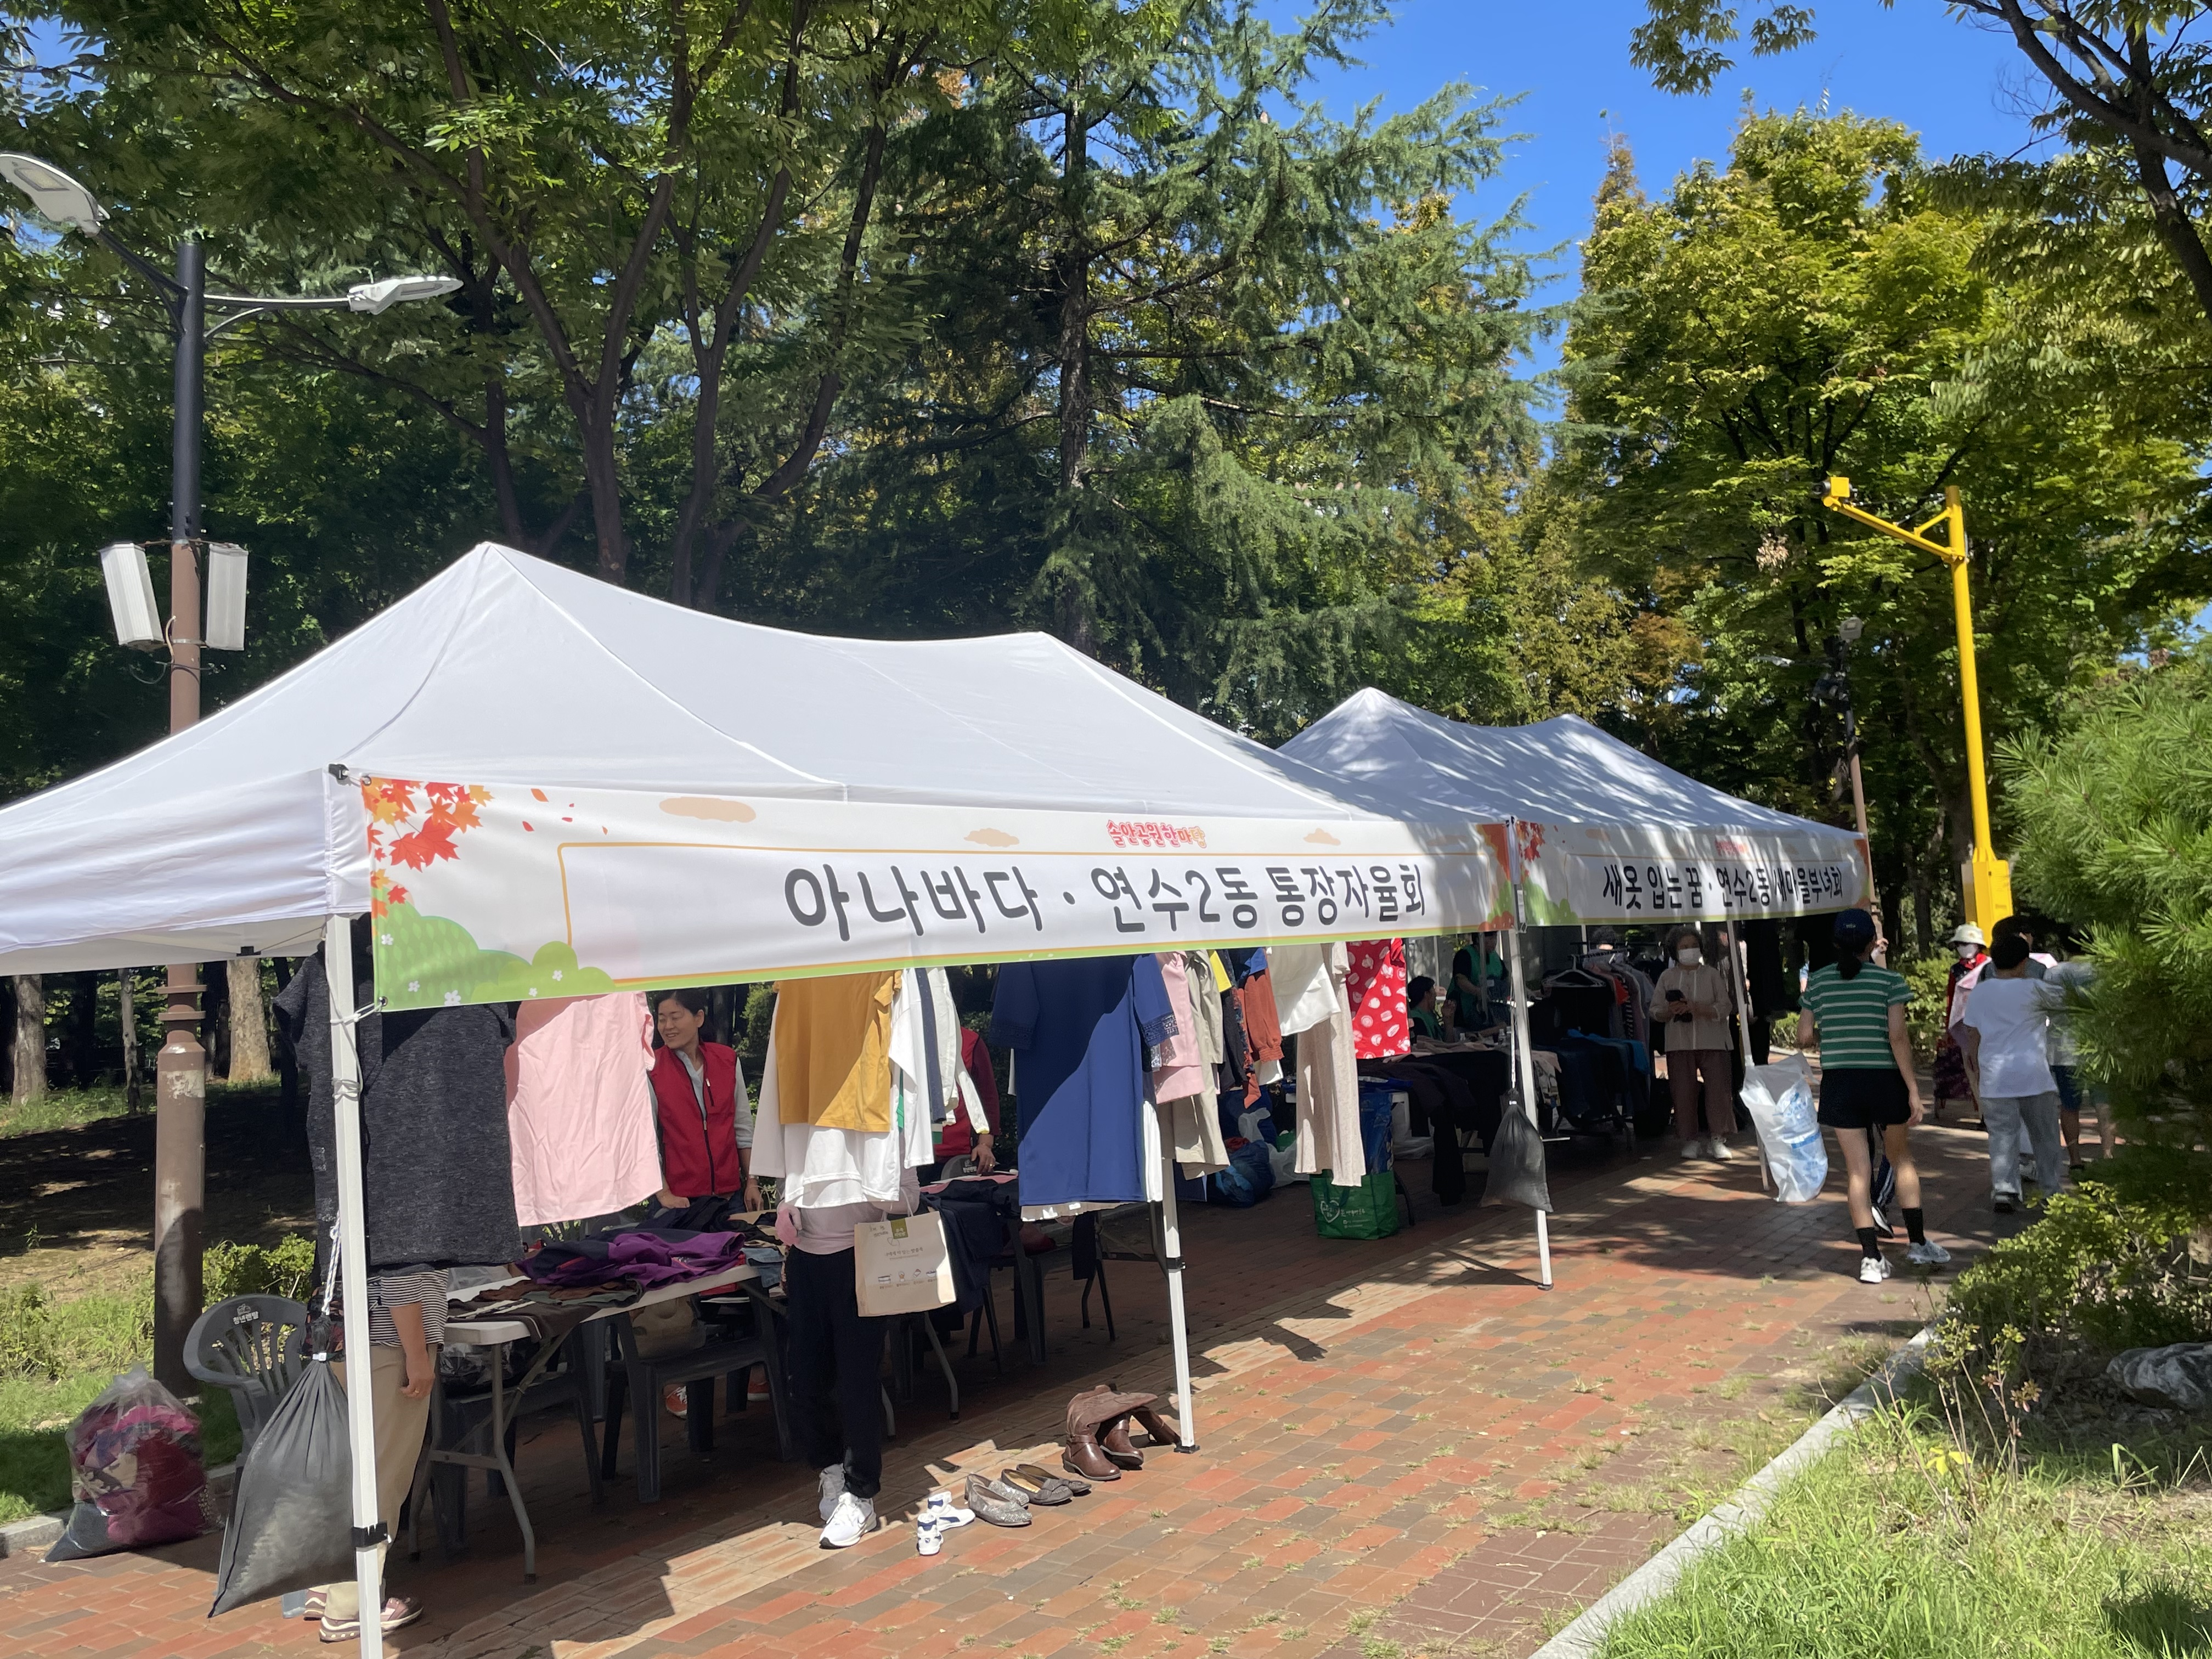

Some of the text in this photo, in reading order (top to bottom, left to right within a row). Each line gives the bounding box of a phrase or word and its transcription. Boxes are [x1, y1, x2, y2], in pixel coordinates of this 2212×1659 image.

[785, 864, 1042, 942] 아나바다
[1090, 865, 1259, 933] 연수2동
[1265, 863, 1425, 927] 통장자율회
[1603, 864, 1642, 910] 새옷
[1647, 866, 1683, 910] 입는
[1685, 867, 1703, 909] 꿈
[1716, 866, 1770, 907] 연수2동
[1773, 866, 1843, 904] 새마을부녀회
